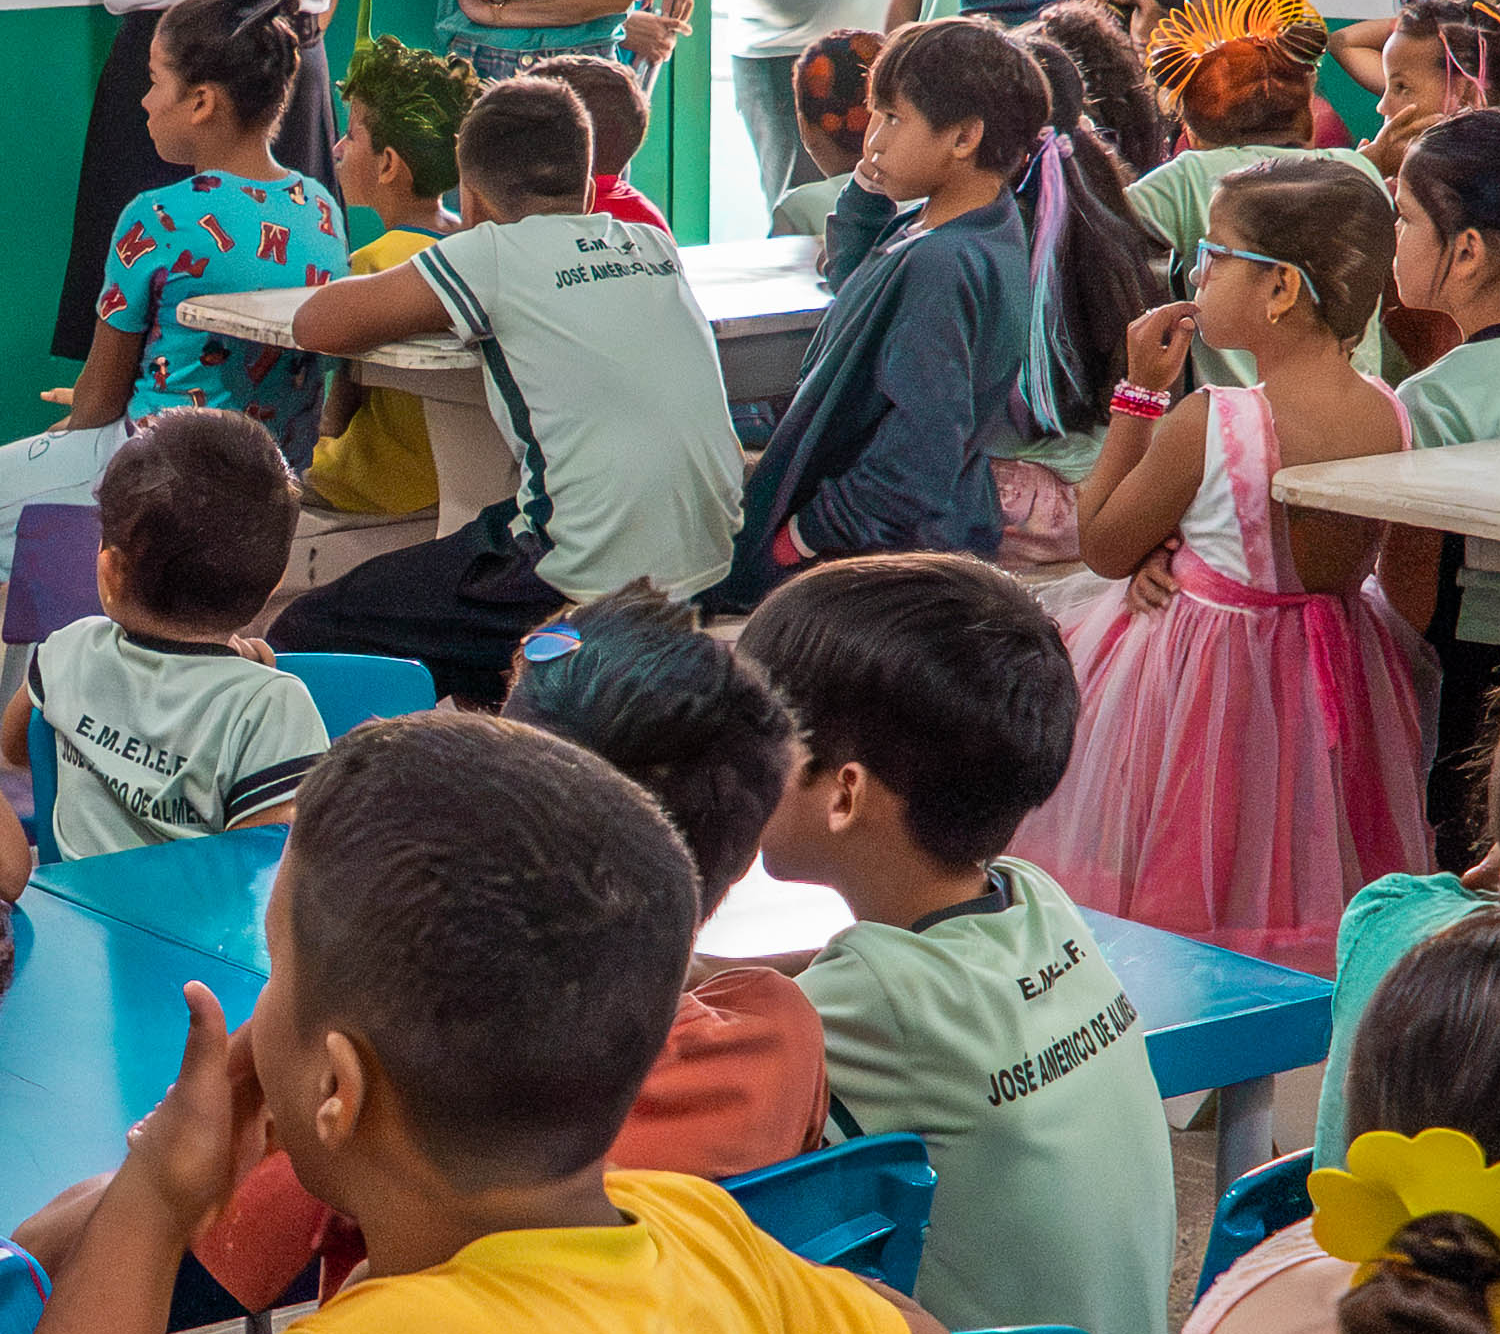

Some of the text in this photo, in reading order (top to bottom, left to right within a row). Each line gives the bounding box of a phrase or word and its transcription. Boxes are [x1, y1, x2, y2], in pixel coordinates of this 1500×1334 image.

[556, 263, 590, 289] JOSÉ
[988, 1051, 1038, 1107] JOSÉ
[1037, 1036, 1098, 1087] AMÉRICO
[1089, 1012, 1117, 1048] DE
